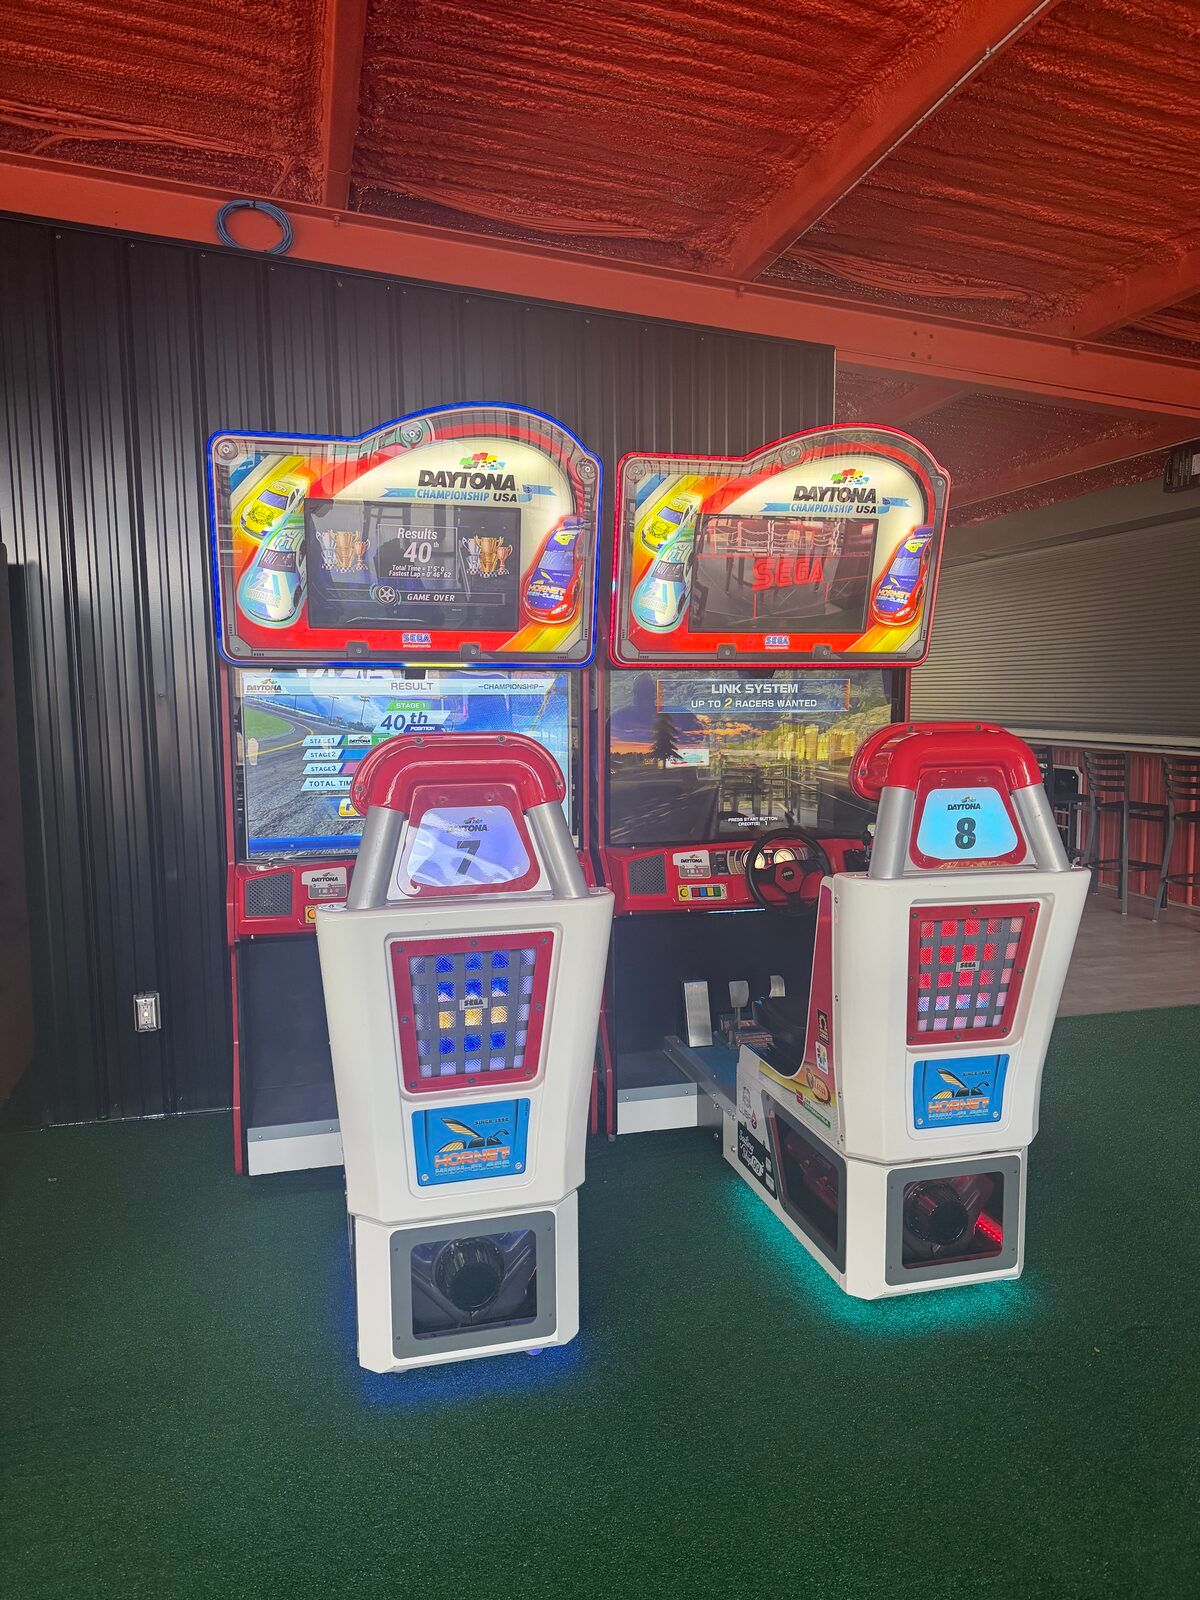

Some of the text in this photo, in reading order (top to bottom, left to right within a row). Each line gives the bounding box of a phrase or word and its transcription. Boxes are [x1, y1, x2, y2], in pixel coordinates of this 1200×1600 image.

[418, 469, 516, 491] DAYTONA
[416, 489, 517, 503] CHAMPIONSHIP USA
[793, 485, 877, 503] DAYTONA
[790, 503, 877, 514] CHAMPIONSHIP USA
[397, 527, 438, 540] Results
[752, 557, 824, 590] SEGA
[407, 593, 455, 602] GAME OVER
[402, 632, 432, 643] SEGA
[764, 635, 790, 645] SEGA
[390, 682, 434, 691] RESULT
[711, 683, 798, 694] LINK SYSTEM
[691, 697, 817, 709] UP TO 2 RACERS WANTED
[446, 824, 489, 833] DAYTONA
[954, 817, 976, 850] 8
[456, 839, 481, 875] 7
[464, 999, 484, 1007] SEGA
[928, 1096, 990, 1114] HORNET
[434, 1145, 511, 1169] HORNET
